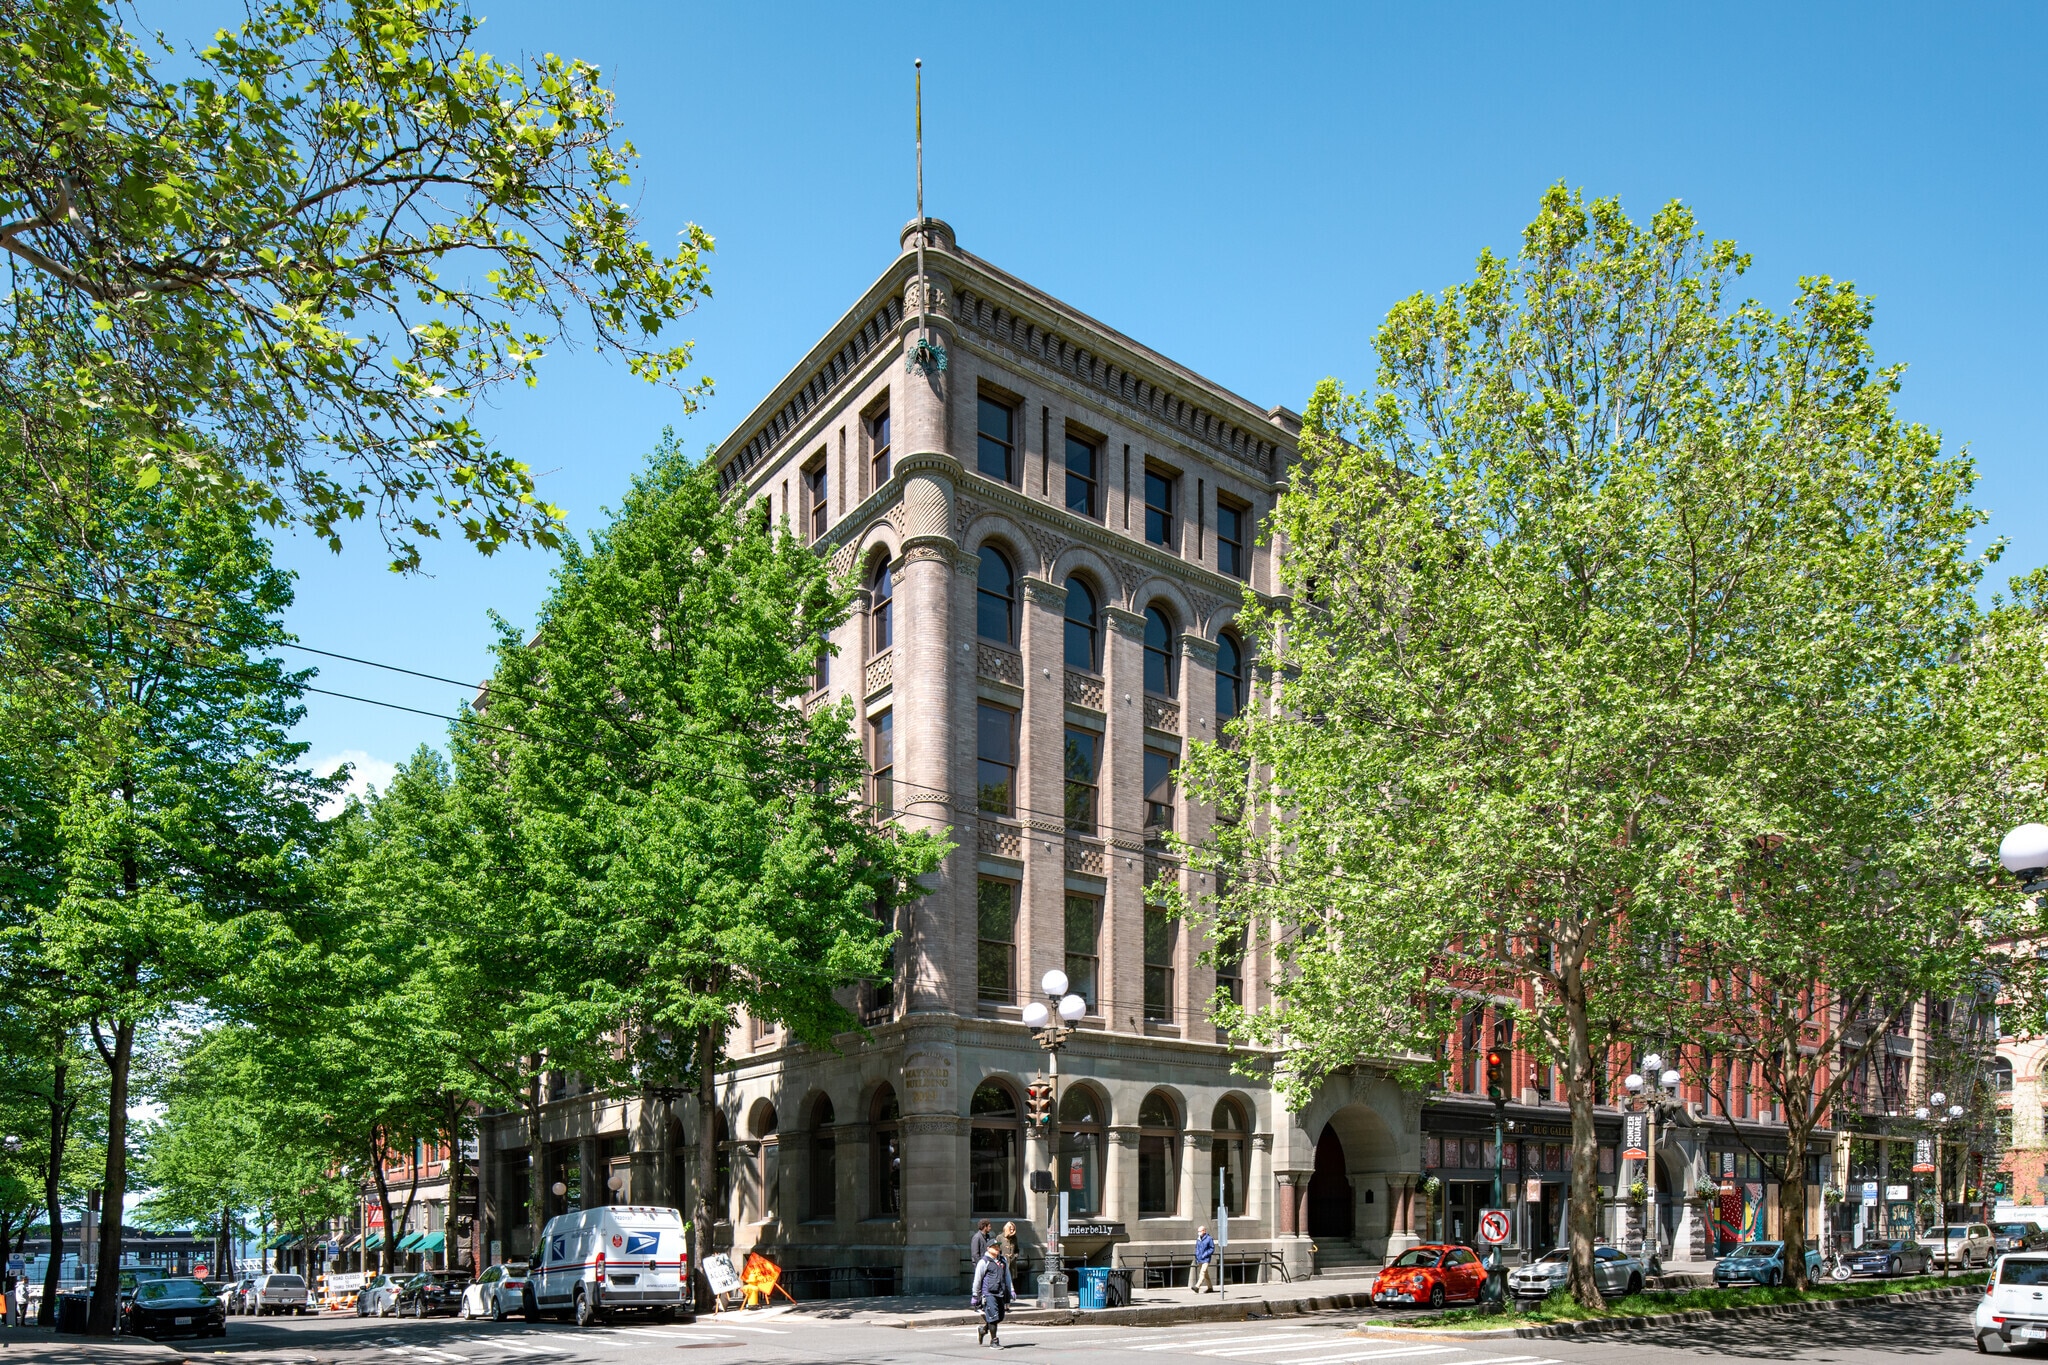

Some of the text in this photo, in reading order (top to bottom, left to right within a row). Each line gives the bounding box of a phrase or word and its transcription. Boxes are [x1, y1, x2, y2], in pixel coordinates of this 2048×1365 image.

[905, 1069, 949, 1079] MAYNARD
[906, 1079, 949, 1088] BUILDING
[1491, 1122, 1524, 1134] TRBI
[1533, 1125, 1547, 1135] RUG
[1626, 1115, 1634, 1148] PIONEER
[1634, 1115, 1642, 1148] SQUARE
[710, 1268, 735, 1280] ACCESS
[718, 1278, 734, 1288] ONLY
